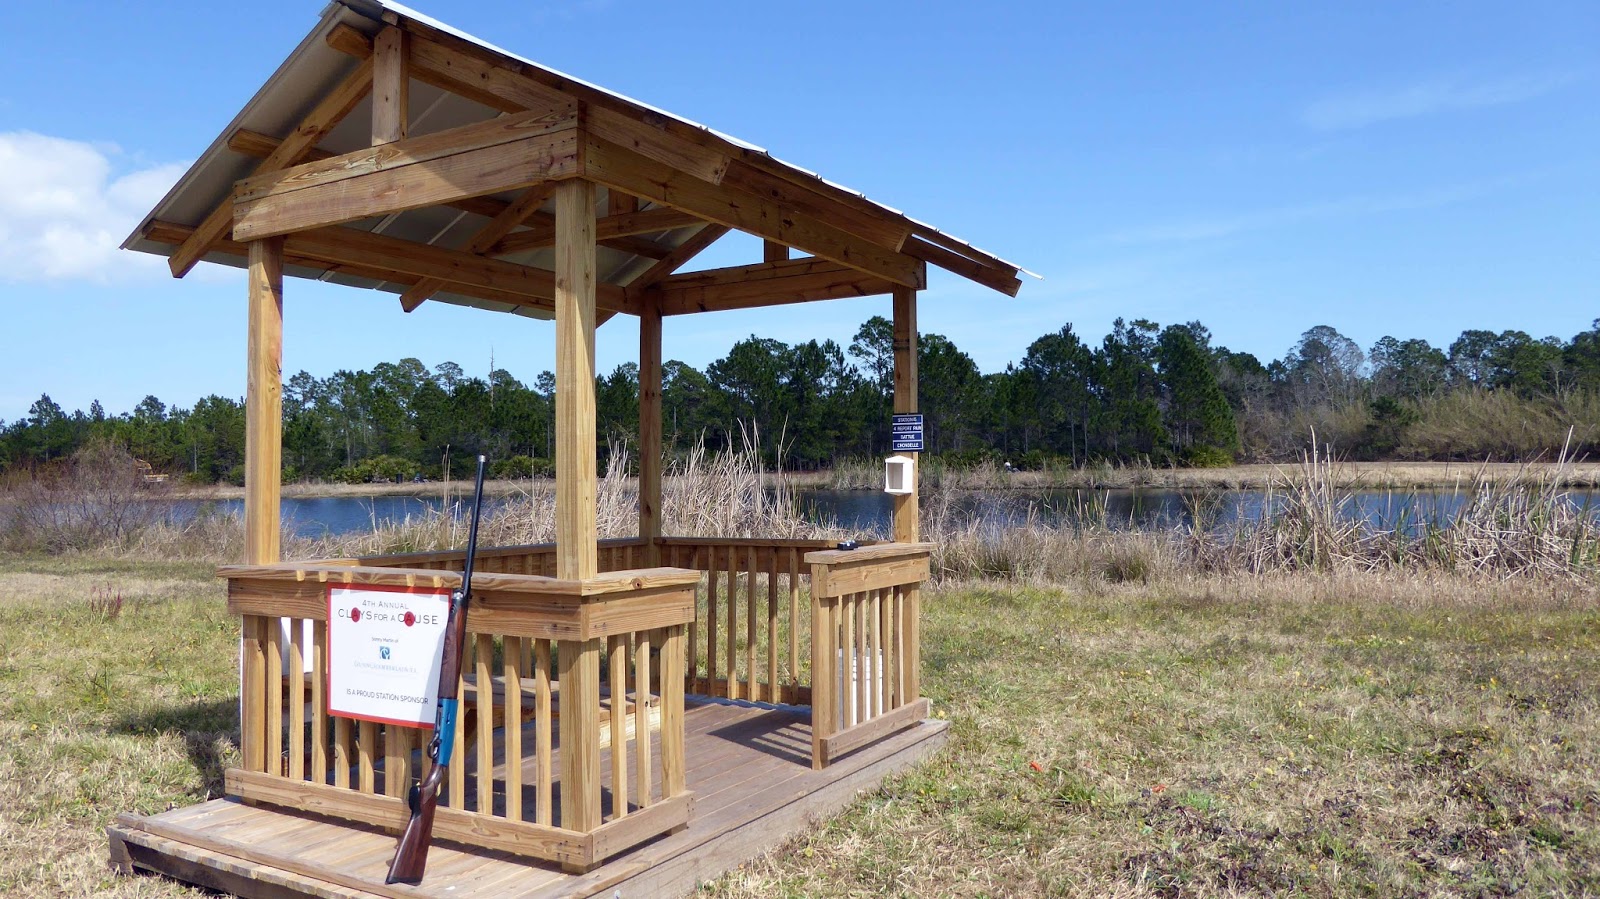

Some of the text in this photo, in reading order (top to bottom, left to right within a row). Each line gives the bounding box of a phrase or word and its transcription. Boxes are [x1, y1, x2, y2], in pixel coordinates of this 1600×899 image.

[362, 599, 409, 610] 4TH ANNUAL
[338, 608, 372, 620] CLAYS
[373, 613, 388, 622] FOR
[397, 613, 438, 625] CAUSE
[356, 690, 375, 699] PROUD
[376, 692, 399, 701] STATION
[400, 695, 429, 704] SPONSOR
